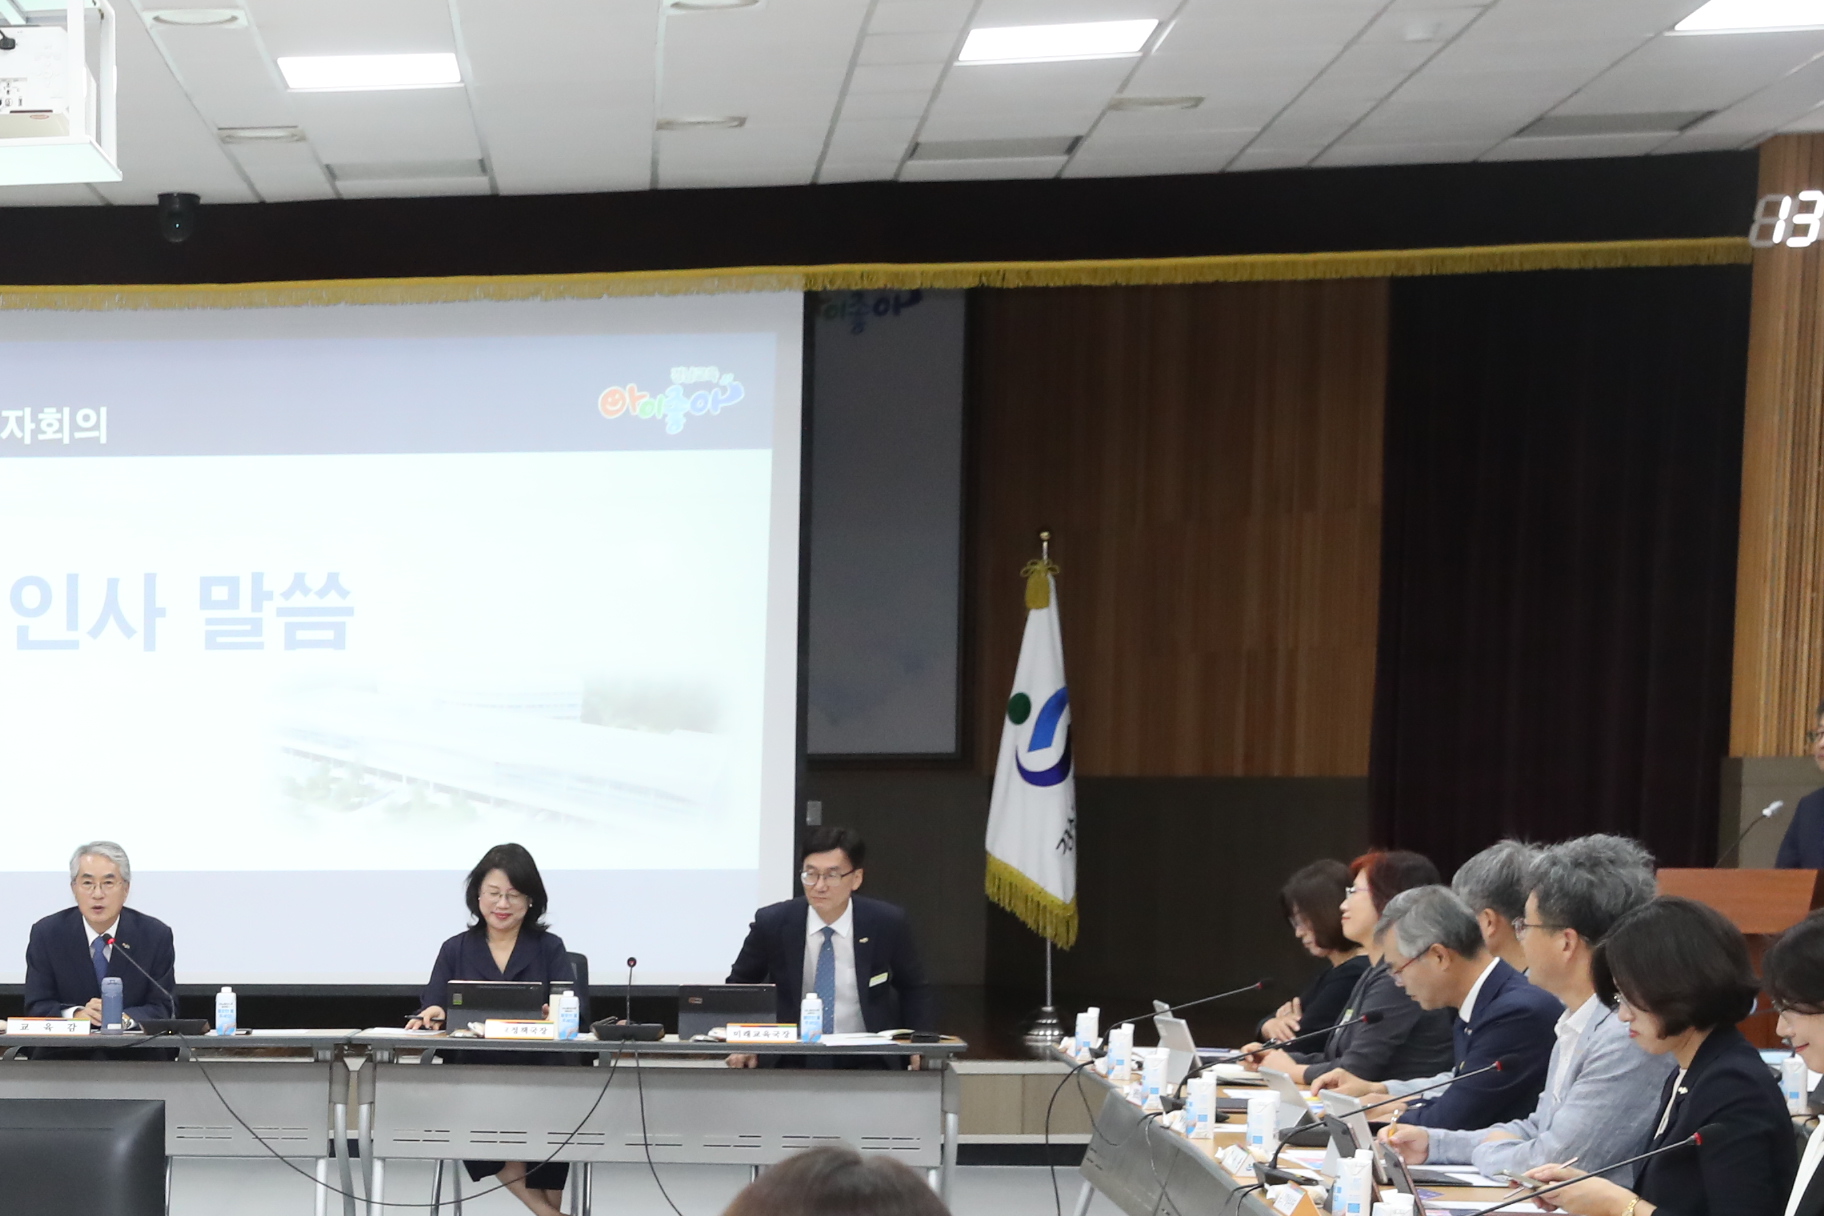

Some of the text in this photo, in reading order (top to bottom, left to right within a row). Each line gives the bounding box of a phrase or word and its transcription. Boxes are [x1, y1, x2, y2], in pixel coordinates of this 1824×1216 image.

[598, 380, 745, 435] 아이좋아
[9, 572, 166, 653] 인사
[198, 571, 355, 652] 말씀
